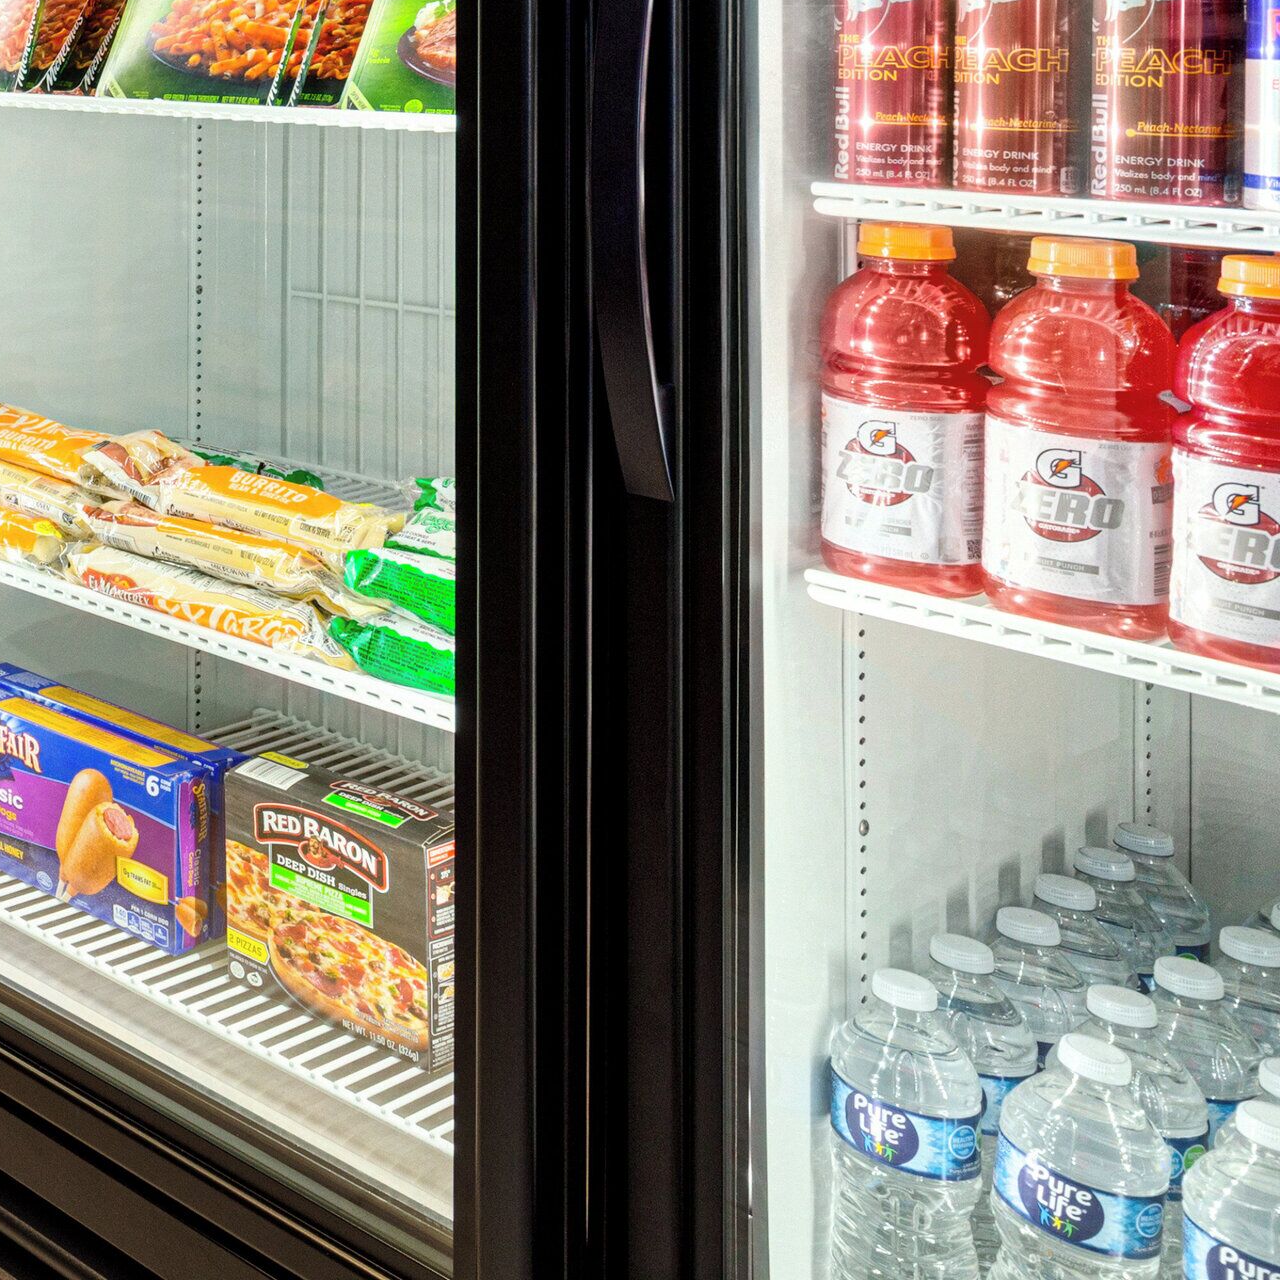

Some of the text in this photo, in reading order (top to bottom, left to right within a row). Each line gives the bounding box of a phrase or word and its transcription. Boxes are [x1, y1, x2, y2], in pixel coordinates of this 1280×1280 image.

[839, 34, 860, 43] THE
[1096, 35, 1119, 47] THE
[838, 45, 950, 70] PEACH
[955, 47, 1070, 72] PEACH
[1096, 48, 1232, 75] PEACH
[838, 69, 898, 81] EDITION
[1096, 75, 1164, 88] EDITION
[834, 86, 850, 180] Red Bull
[1137, 121, 1223, 135] Peach-Nectarine
[856, 141, 933, 154] ENERGY DRINK
[1091, 93, 1108, 196] Red Bull
[887, 155, 907, 166] body
[908, 156, 925, 165] and
[962, 148, 1040, 160] ENERGY DRINK
[1115, 154, 1205, 168] ENERGY DRINK
[856, 168, 872, 178] 250
[873, 169, 884, 178] mL
[989, 164, 1029, 174] body and
[1114, 168, 1219, 183] Vitalizes body and mind
[1008, 178, 1017, 187] FL
[1114, 184, 1132, 194] 250
[1036, 448, 1082, 489] G
[229, 471, 310, 503] BURRITO
[1212, 482, 1260, 526] G
[1056, 561, 1085, 572] PUNCH
[145, 775, 160, 797] 6
[338, 792, 363, 804] DEEP
[342, 782, 429, 817] RED BARON
[4, 842, 24, 860] HONEY
[263, 811, 378, 877] RED BARON
[130, 872, 152, 887] TRANS FAT
[276, 853, 306, 873] DEEP
[307, 866, 336, 887] DISH
[338, 882, 367, 900] Singles
[229, 933, 263, 957] 2 PIZZAS
[342, 1019, 356, 1034] NET
[853, 1093, 906, 1130] Pure
[859, 1113, 903, 1145] Life
[1028, 1162, 1092, 1207] Pure
[1036, 1184, 1082, 1221] Life
